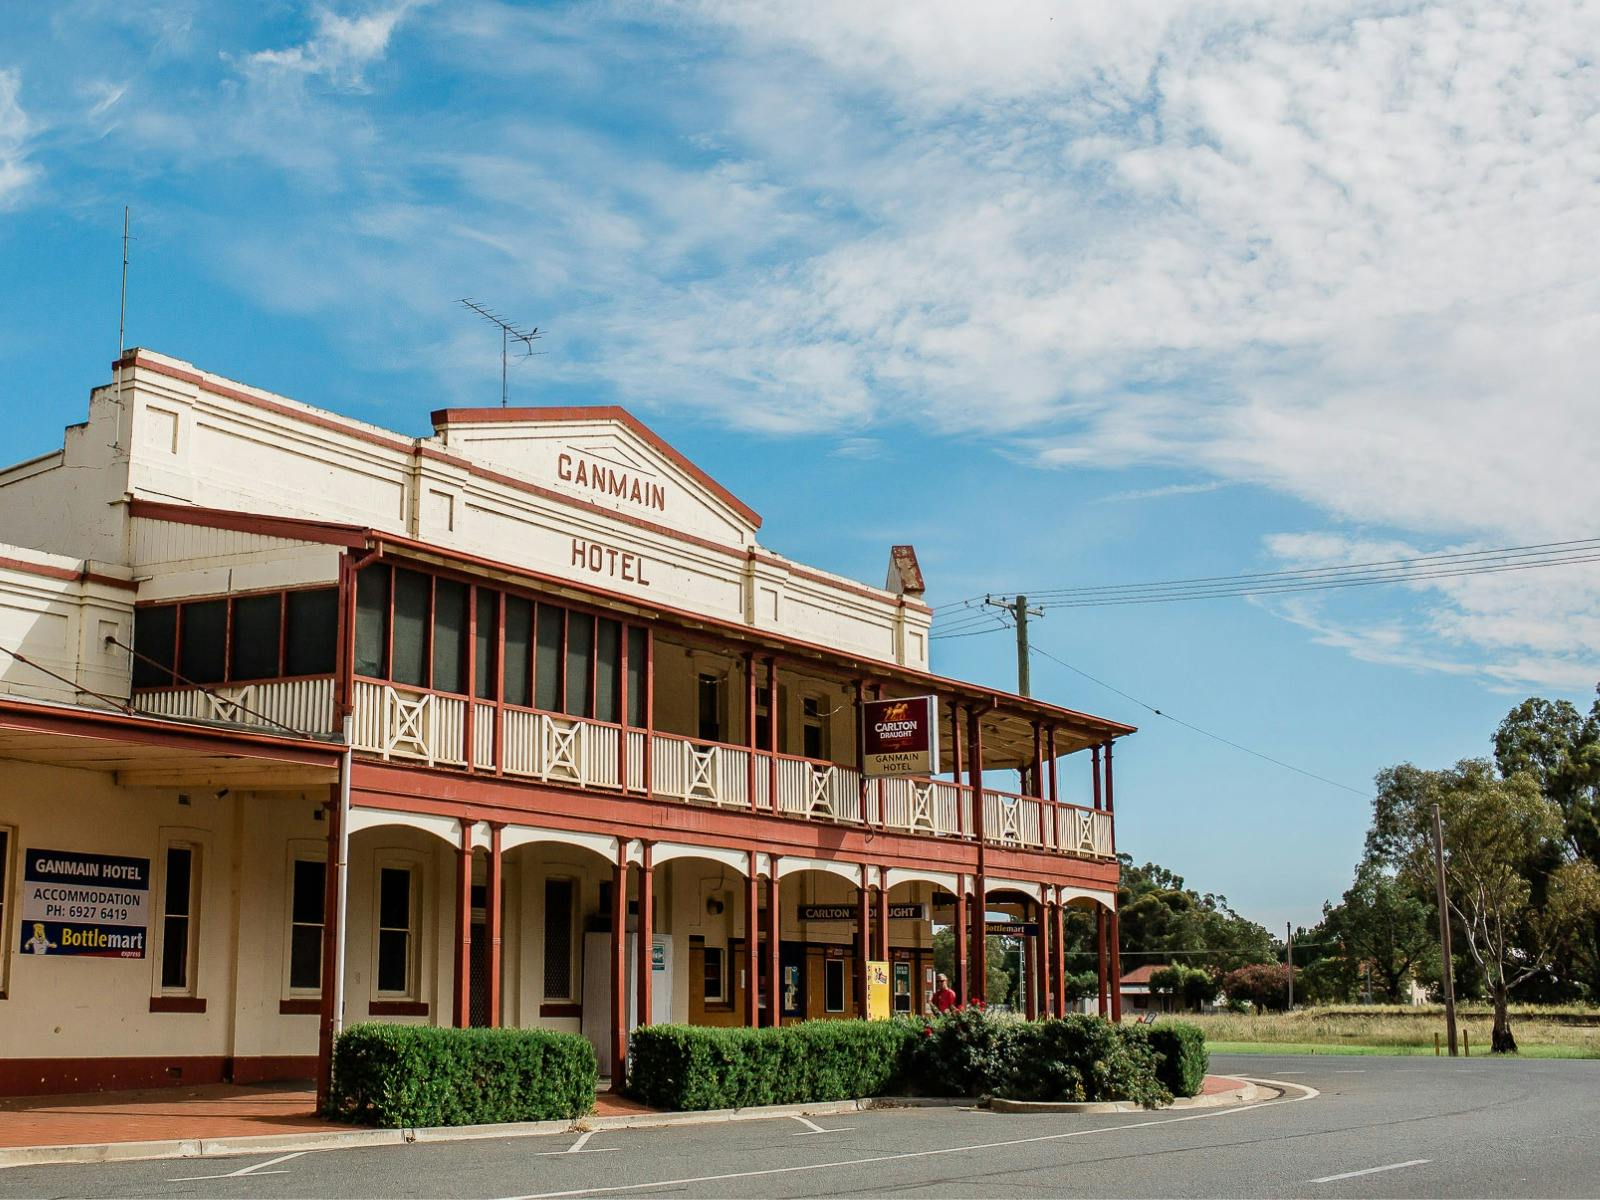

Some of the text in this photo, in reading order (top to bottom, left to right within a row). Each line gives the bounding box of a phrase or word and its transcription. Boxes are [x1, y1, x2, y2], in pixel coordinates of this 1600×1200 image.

[558, 453, 665, 511] GANMAIN
[571, 539, 650, 586] HOTEL
[875, 721, 917, 732] CARLTON
[880, 731, 912, 739] DRAUGHT
[875, 753, 919, 763] GANMAIN
[884, 763, 912, 771] HOTEL
[35, 858, 141, 880] GANMAIN HOTEL
[34, 888, 140, 905] ACCOMMODATION
[46, 905, 128, 920] PH: 6927 6419
[805, 909, 850, 918] CARLTON
[62, 928, 143, 949] Bottlemart
[121, 950, 141, 958] express
